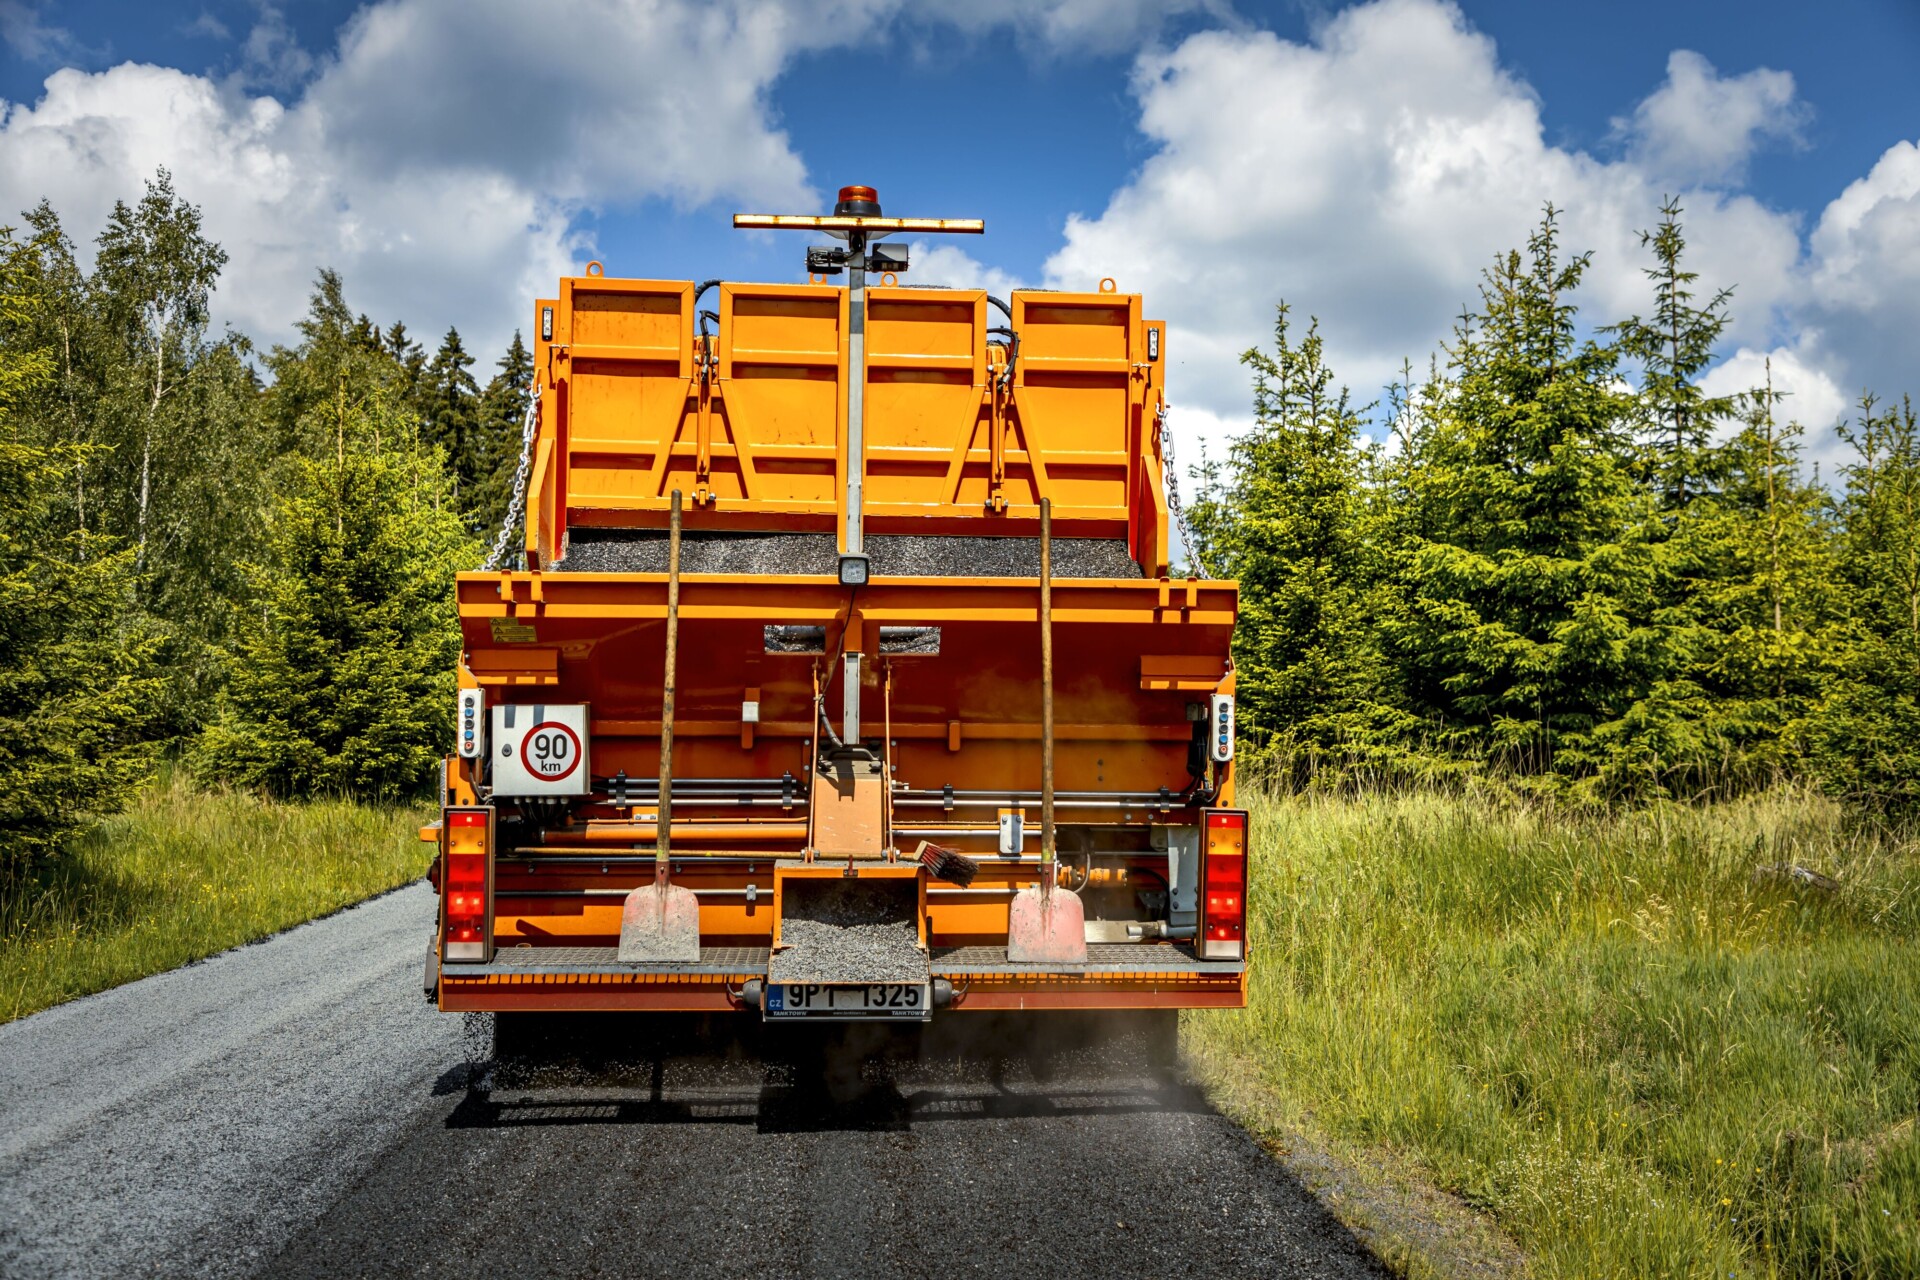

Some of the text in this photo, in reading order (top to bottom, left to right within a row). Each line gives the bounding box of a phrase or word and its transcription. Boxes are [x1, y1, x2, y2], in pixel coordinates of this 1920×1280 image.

[535, 734, 567, 759] 90
[541, 760, 561, 772] km
[769, 999, 781, 1007] CZ
[859, 984, 919, 1007] 1325
